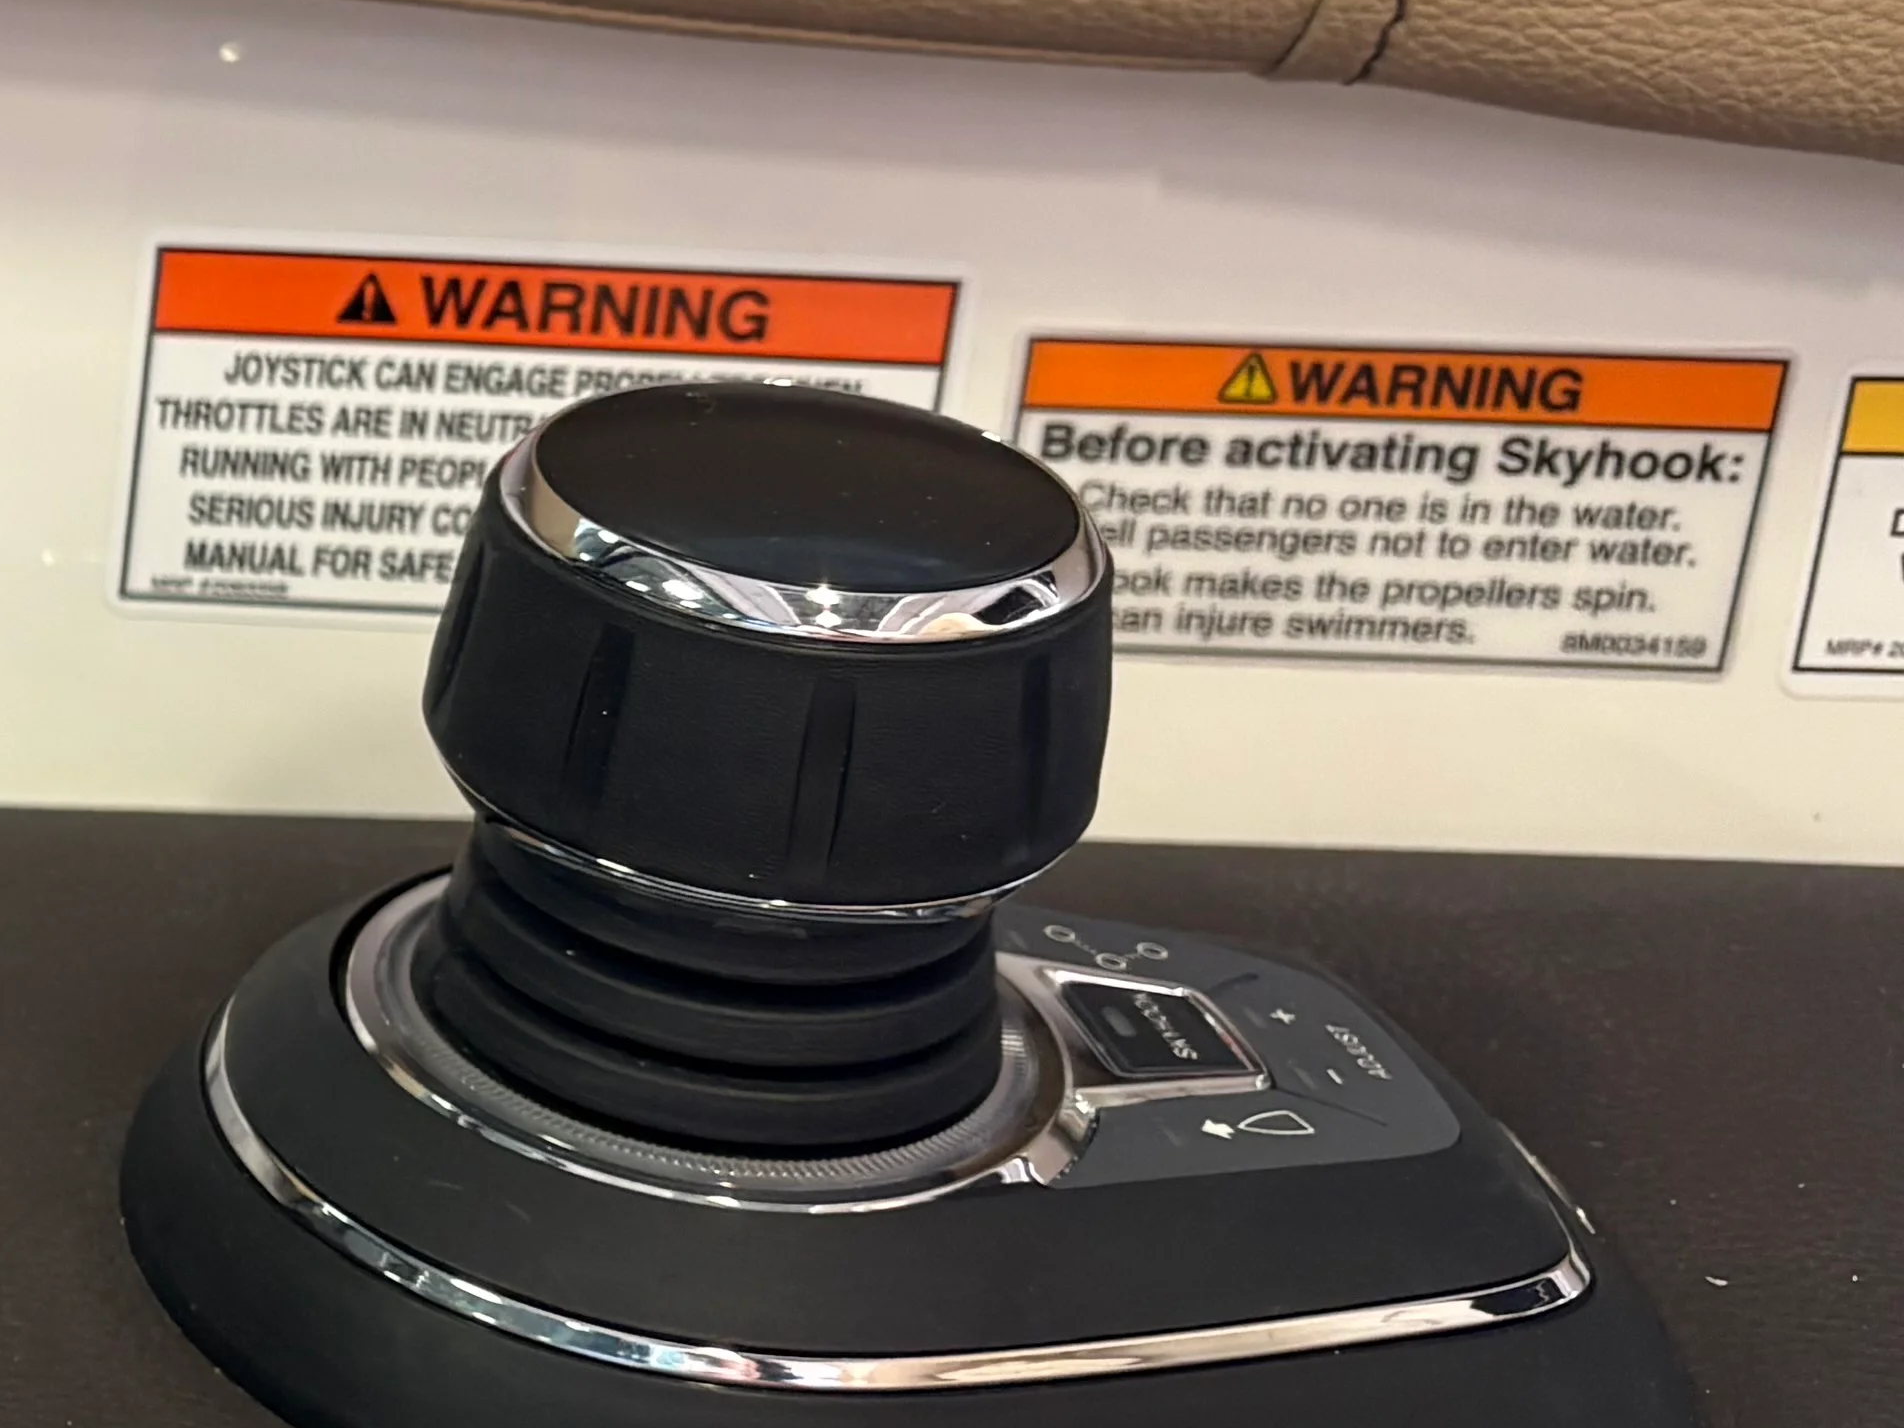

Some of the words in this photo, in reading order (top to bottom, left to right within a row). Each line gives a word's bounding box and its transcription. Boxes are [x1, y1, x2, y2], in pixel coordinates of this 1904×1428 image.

[422, 275, 771, 343] WARNING
[223, 352, 367, 389] JOYSTICK
[374, 357, 436, 390] CAN
[445, 360, 568, 397] ENGAGE
[1290, 361, 1584, 413] WARNING
[156, 398, 324, 435] THROTTLES
[331, 403, 392, 438] ARE
[399, 409, 428, 438] IN
[435, 411, 537, 441] NEUTR
[179, 445, 311, 483] RUNNING
[319, 450, 391, 485] WITH
[1042, 422, 1211, 465] Before
[1225, 430, 1478, 486] activating
[1497, 434, 1744, 488] Skyhook:
[188, 491, 315, 529] SERIOUS
[321, 498, 425, 533] INJURY
[1079, 479, 1191, 515] Check
[1203, 486, 1273, 518] that
[1282, 492, 1328, 520] no
[1338, 496, 1406, 523] one
[1418, 490, 1449, 520] is
[1459, 492, 1491, 525] in
[1505, 494, 1559, 527] the
[1574, 501, 1681, 533] water.
[183, 539, 307, 577] MANUAL
[312, 544, 372, 580] FOR
[1099, 519, 1136, 545] ell
[1146, 523, 1357, 561] passengers
[1369, 528, 1426, 558] not
[1438, 529, 1471, 559] to
[1482, 535, 1578, 564] enter
[1591, 537, 1697, 568] water.
[1182, 567, 1303, 602] makes
[1315, 573, 1370, 603] the
[1379, 576, 1561, 613] propellers
[1572, 580, 1657, 617] spin.
[1173, 602, 1273, 641] injure
[1286, 610, 1476, 645] swimmers.
